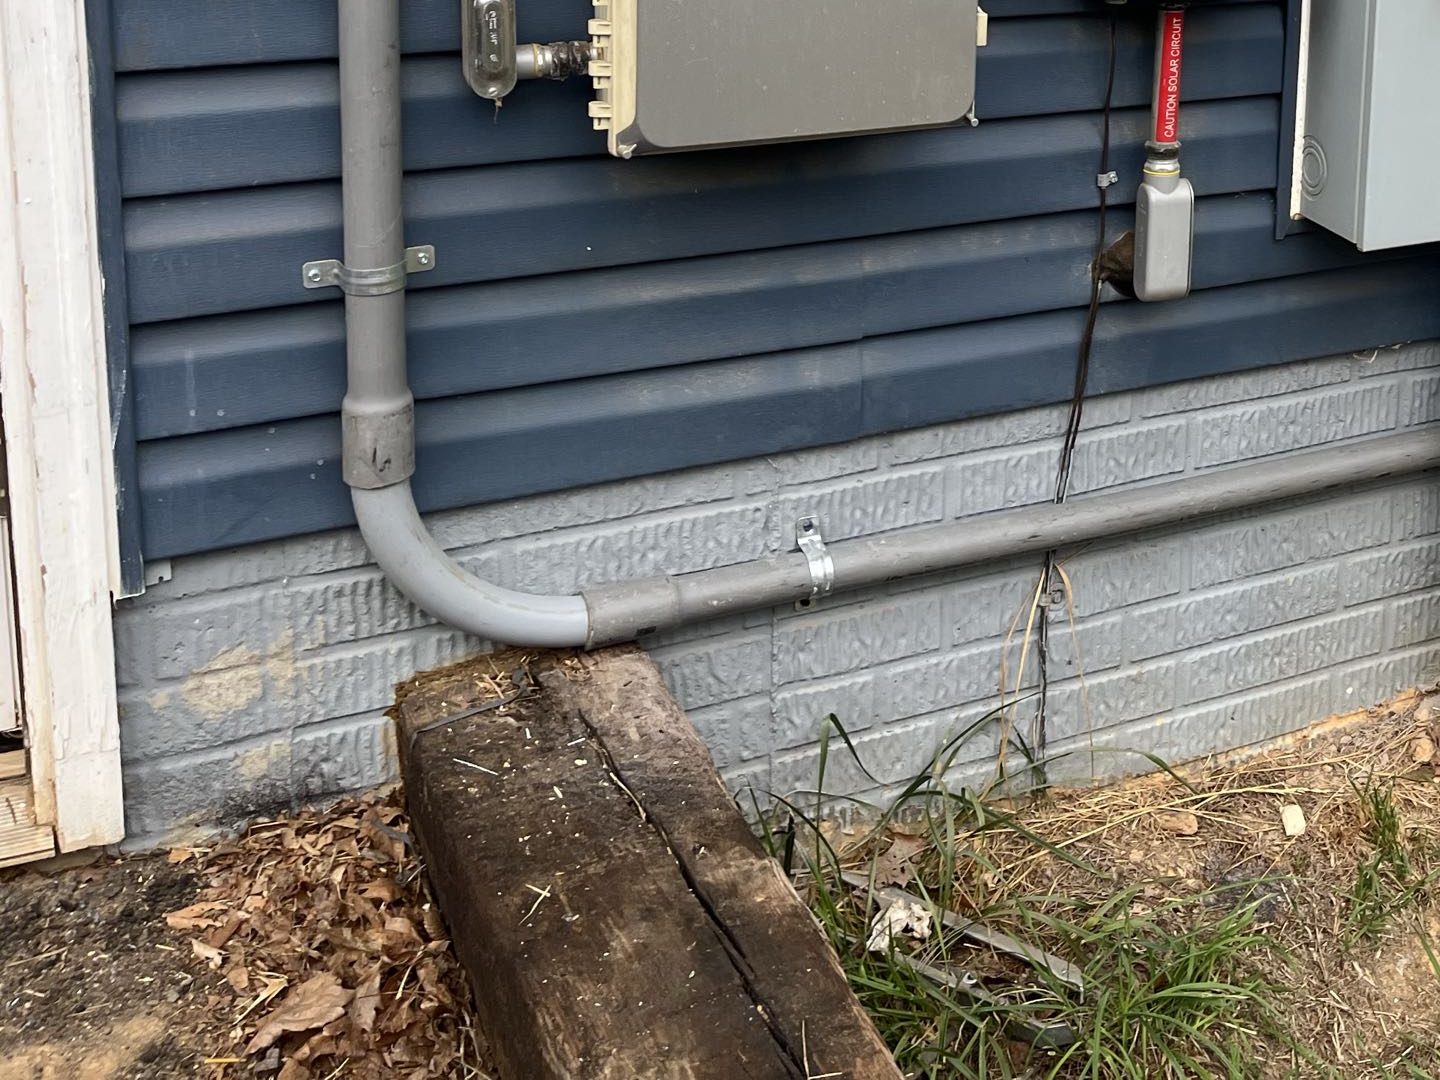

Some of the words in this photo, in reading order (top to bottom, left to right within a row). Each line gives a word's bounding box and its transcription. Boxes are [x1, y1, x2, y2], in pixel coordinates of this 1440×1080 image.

[1170, 17, 1182, 57] CIRCUIT
[1168, 58, 1180, 93] SOLAR
[1164, 93, 1177, 138] CAUTION
